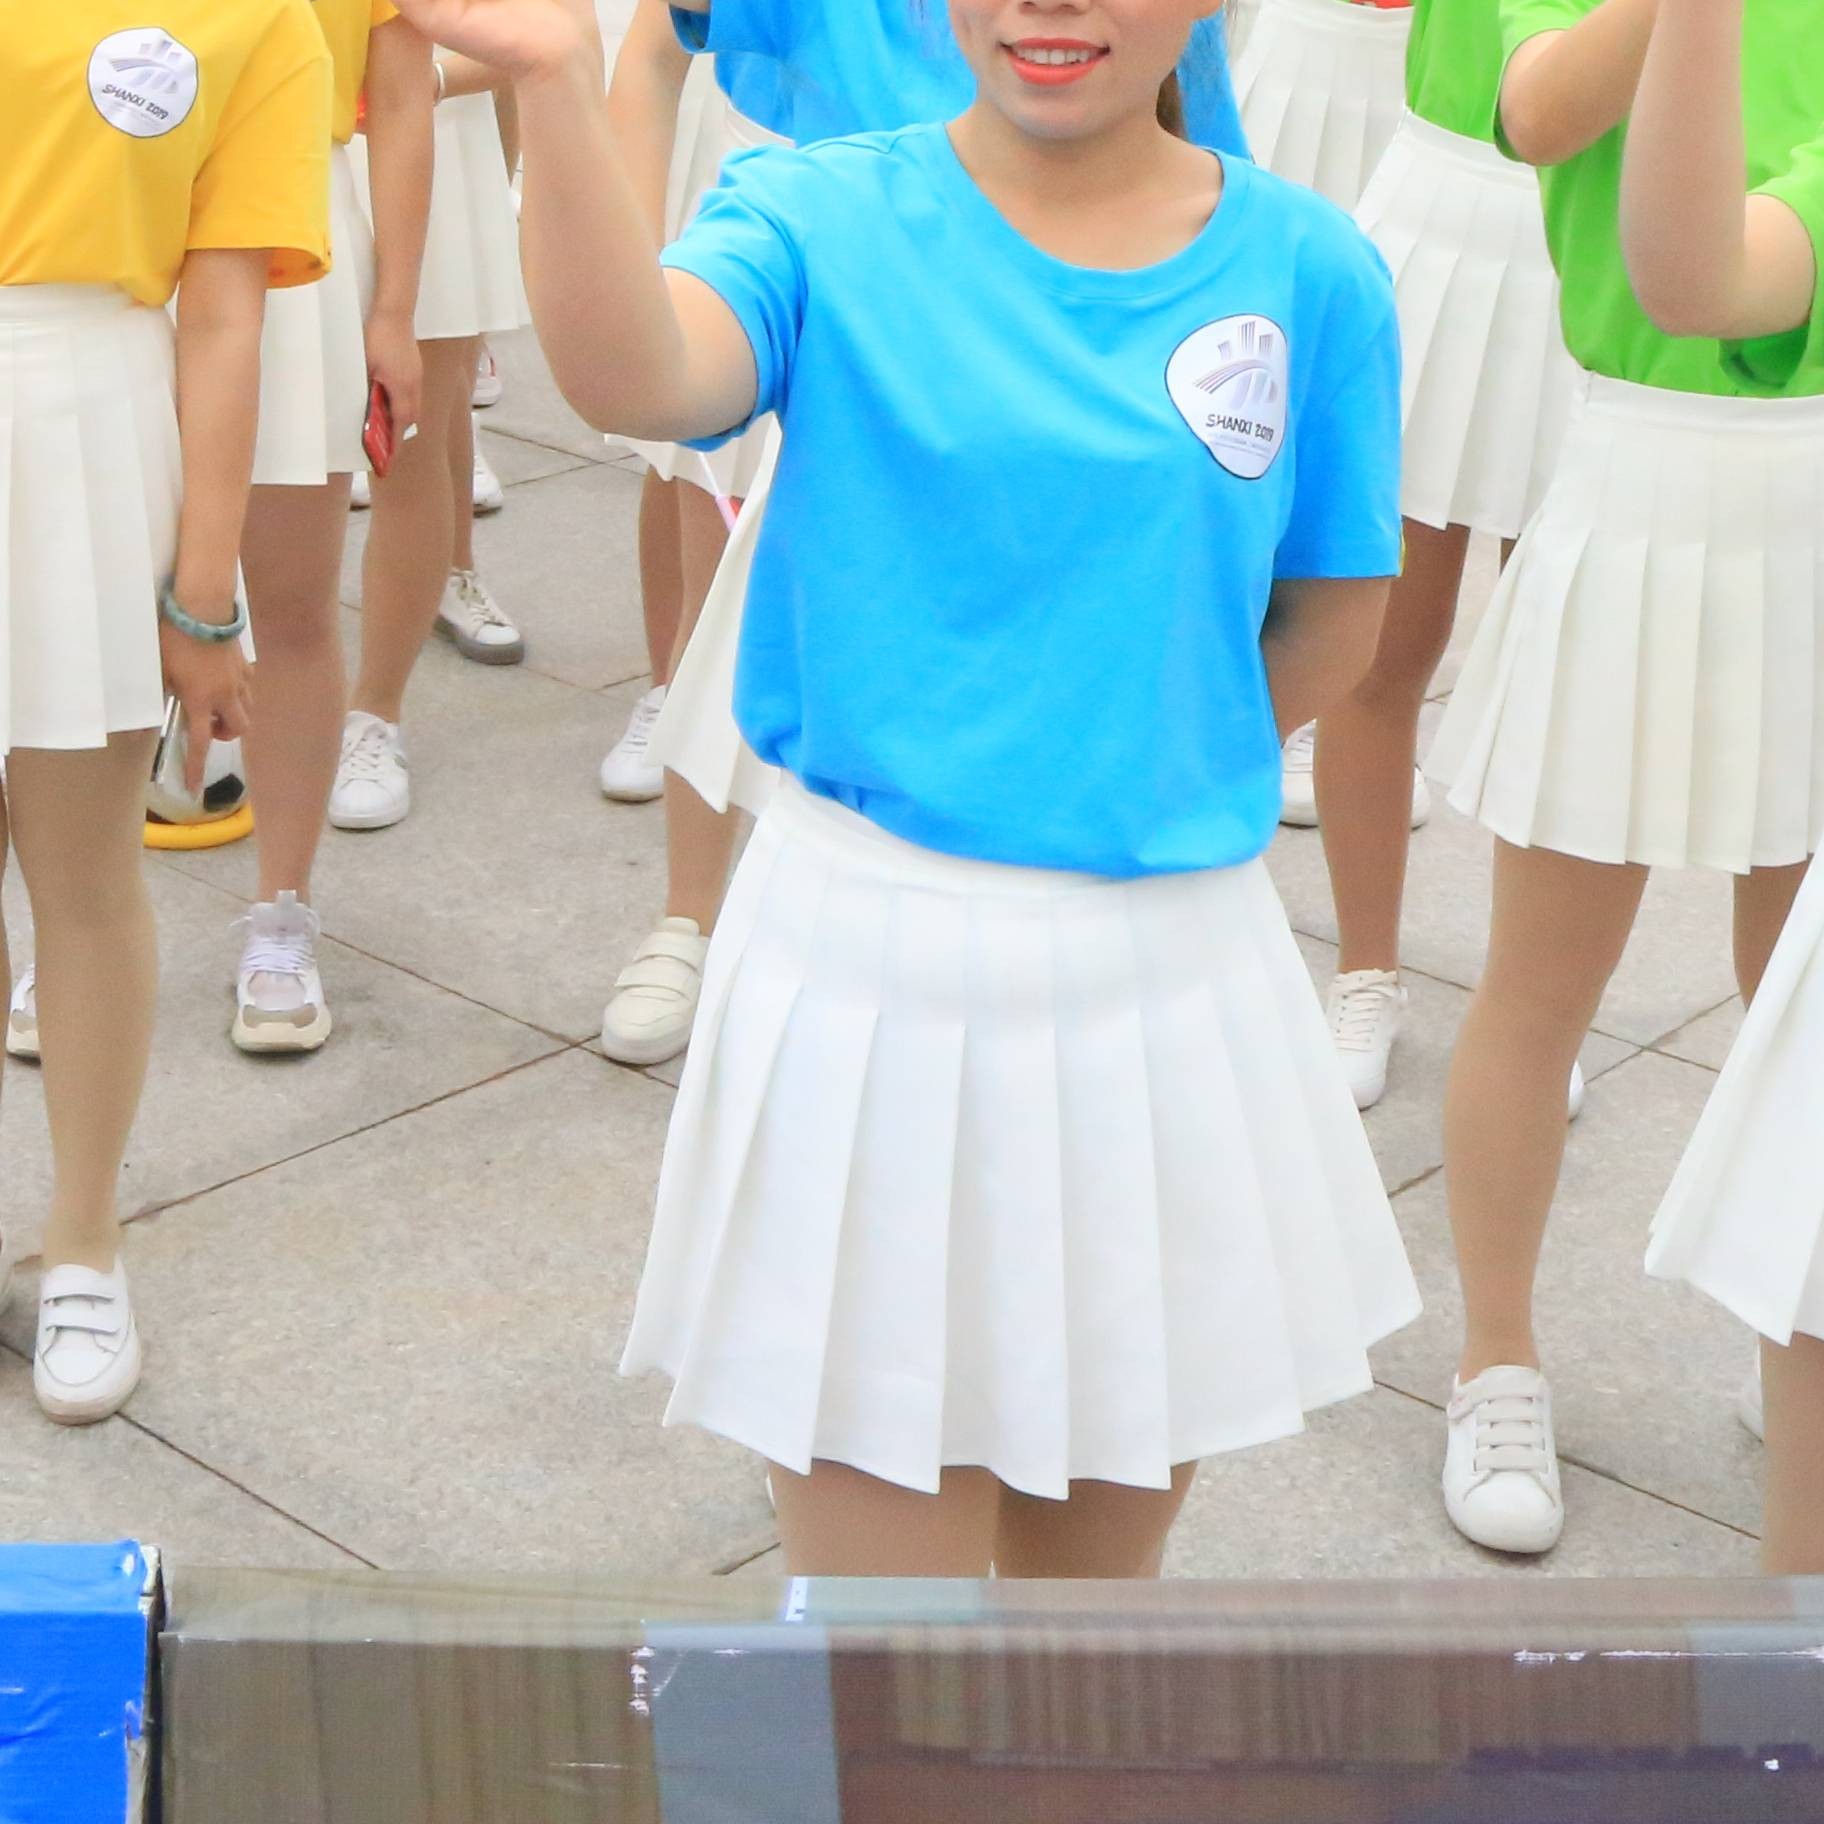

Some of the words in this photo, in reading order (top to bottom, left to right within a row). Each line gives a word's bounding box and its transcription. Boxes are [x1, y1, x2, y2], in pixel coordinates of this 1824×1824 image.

[102, 84, 146, 107] SHANXI
[146, 102, 169, 120] 2019
[1205, 413, 1252, 435] SHANXI
[1254, 423, 1274, 443] 2019
